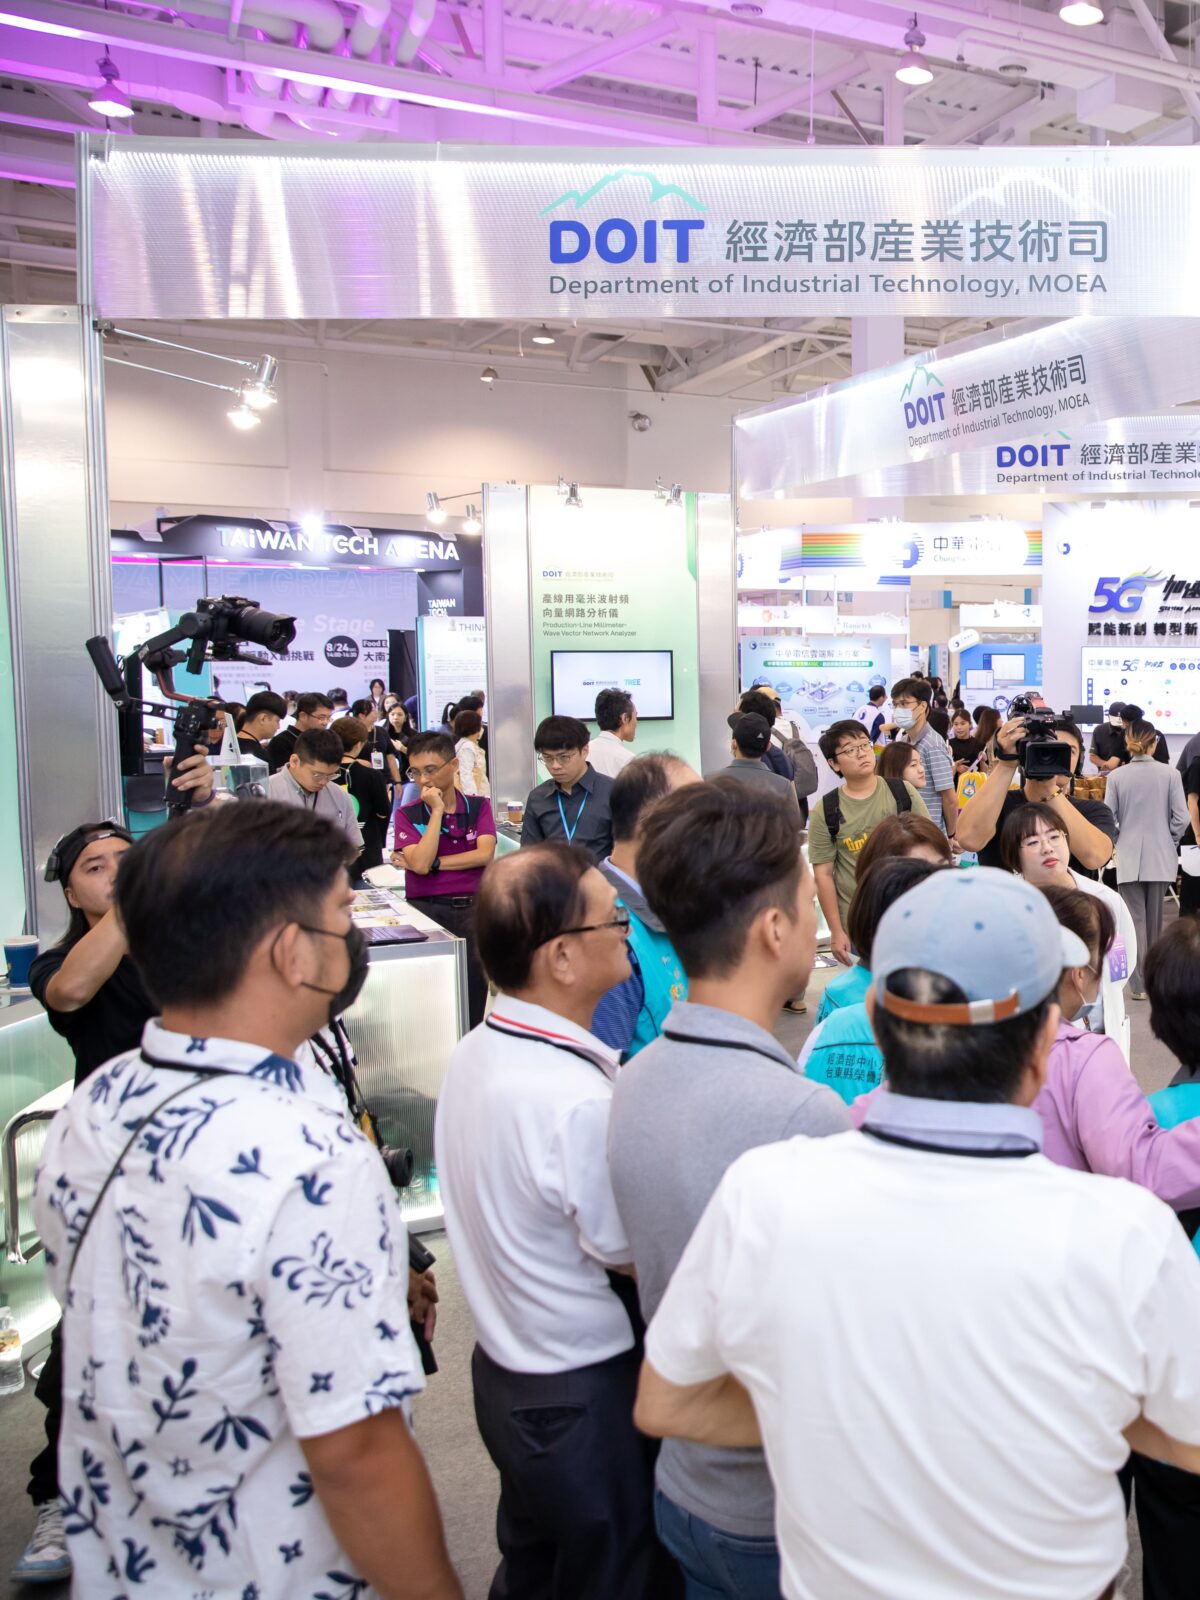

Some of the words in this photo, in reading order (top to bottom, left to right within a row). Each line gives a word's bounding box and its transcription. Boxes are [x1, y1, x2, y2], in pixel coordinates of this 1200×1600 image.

[549, 217, 705, 265] DOIT
[549, 274, 699, 296] Department
[708, 273, 734, 294] of
[742, 273, 861, 294] Industrial
[869, 273, 1022, 298] Technology,
[1029, 274, 1108, 294] MOEA
[903, 391, 945, 430] DOIT
[908, 427, 951, 448] Department
[953, 423, 961, 437] of
[962, 415, 1001, 436] Industrial
[1002, 402, 1058, 425] Technology,
[1058, 393, 1090, 412] MOEA
[996, 444, 1071, 468] DOIT
[997, 472, 1069, 484] Department
[1072, 471, 1086, 481] of
[1088, 470, 1147, 481] Industrial
[542, 570, 563, 578] DOIT
[1088, 577, 1147, 613] 5G
[313, 614, 375, 634] Stage
[542, 621, 593, 629] Production-Line
[611, 630, 637, 638] Analyzer
[1088, 622, 1147, 636] 賦能新創
[326, 643, 349, 652] 8/24
